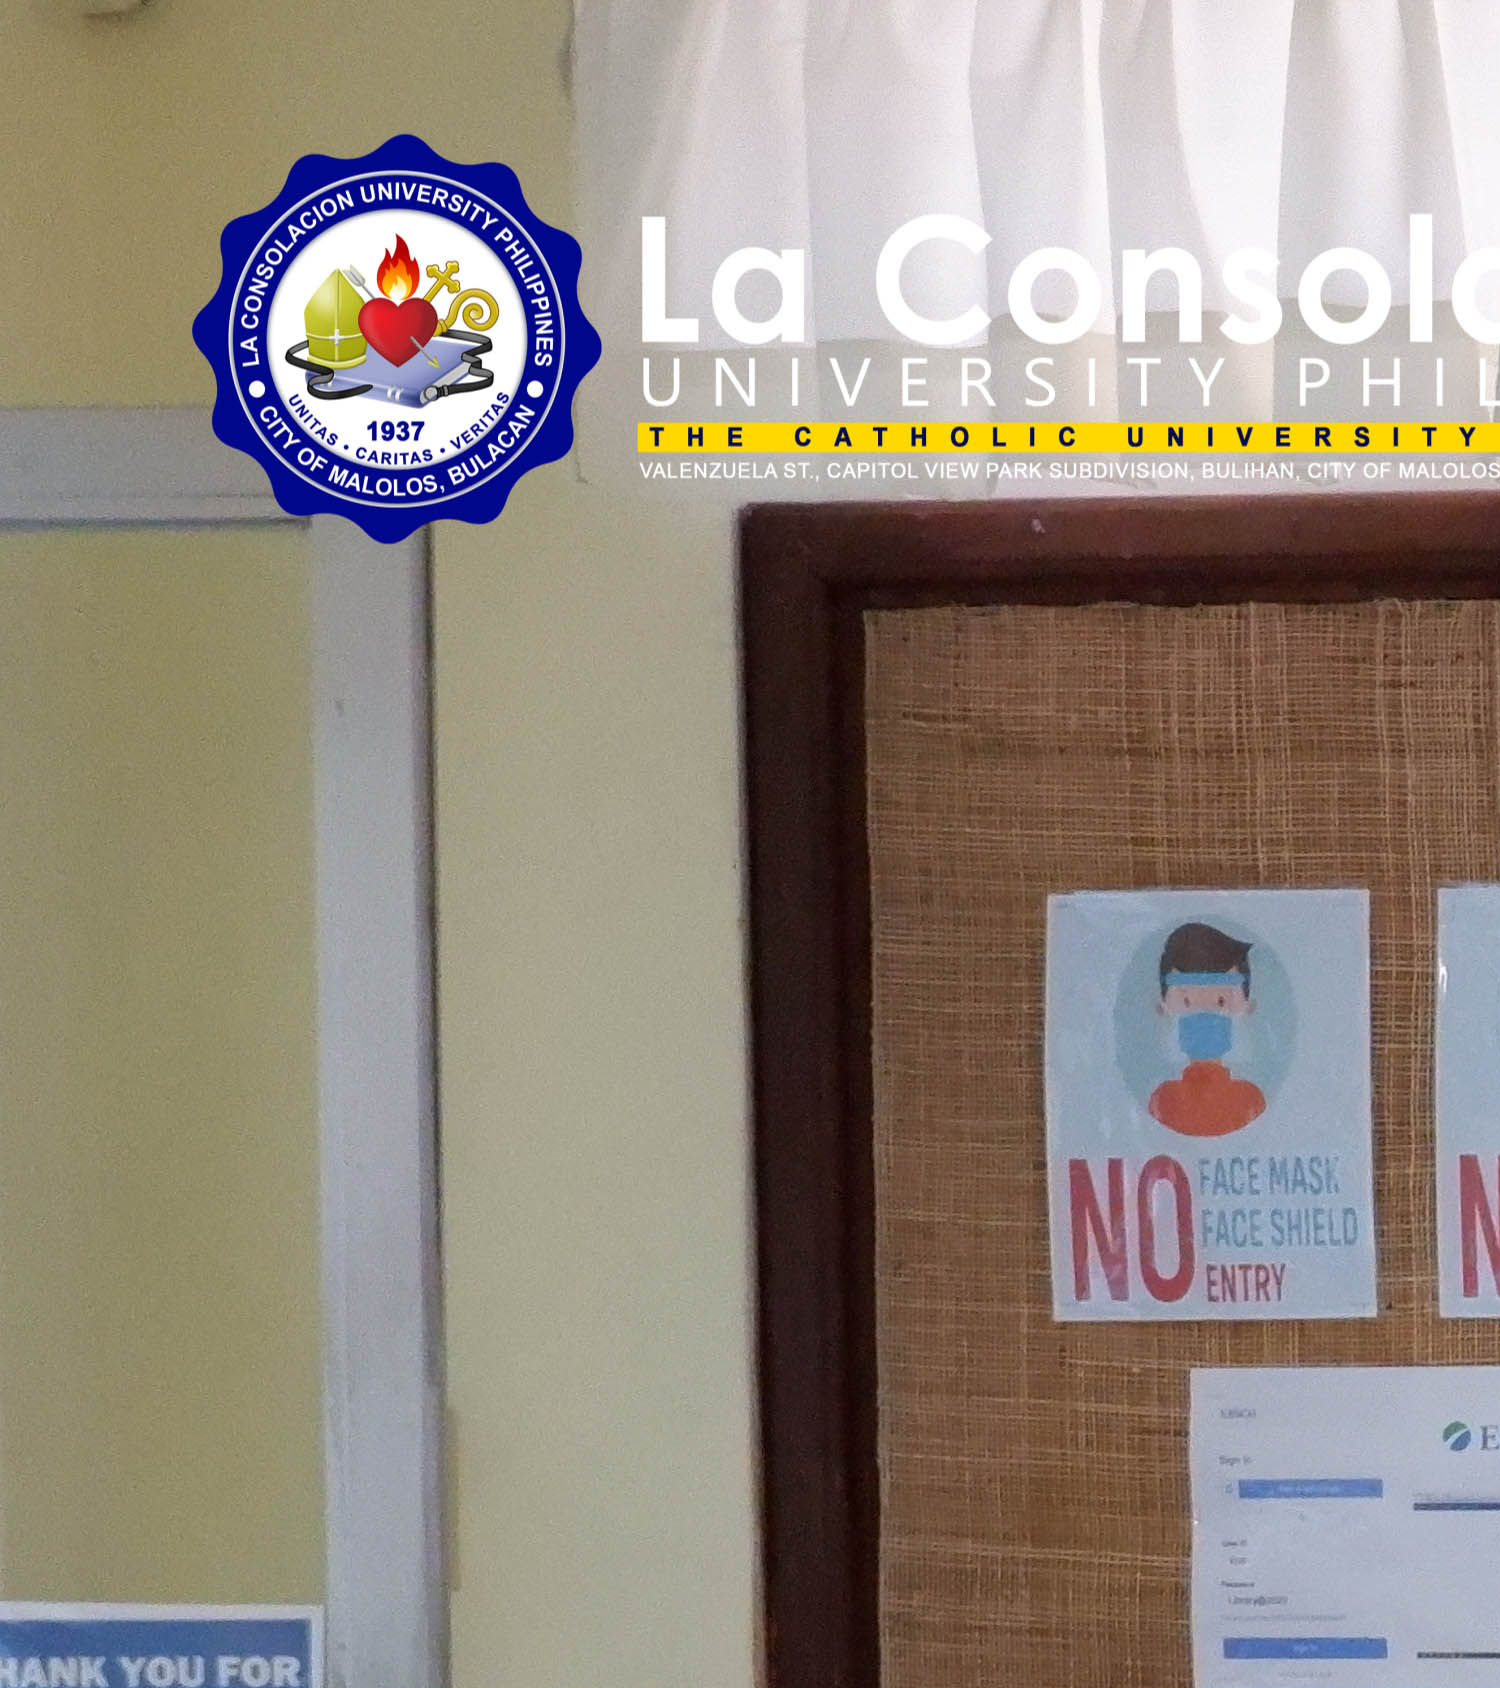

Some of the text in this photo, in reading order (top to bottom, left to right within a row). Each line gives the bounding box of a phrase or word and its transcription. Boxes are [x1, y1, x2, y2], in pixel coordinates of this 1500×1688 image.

[1200, 1156, 1341, 1194] FACE MASK
[1068, 1155, 1196, 1304] NO
[1201, 1206, 1358, 1248] FACE SHIELD
[1206, 1263, 1287, 1302] ENTRY
[0, 1655, 301, 1688] HANK YOU FOR
